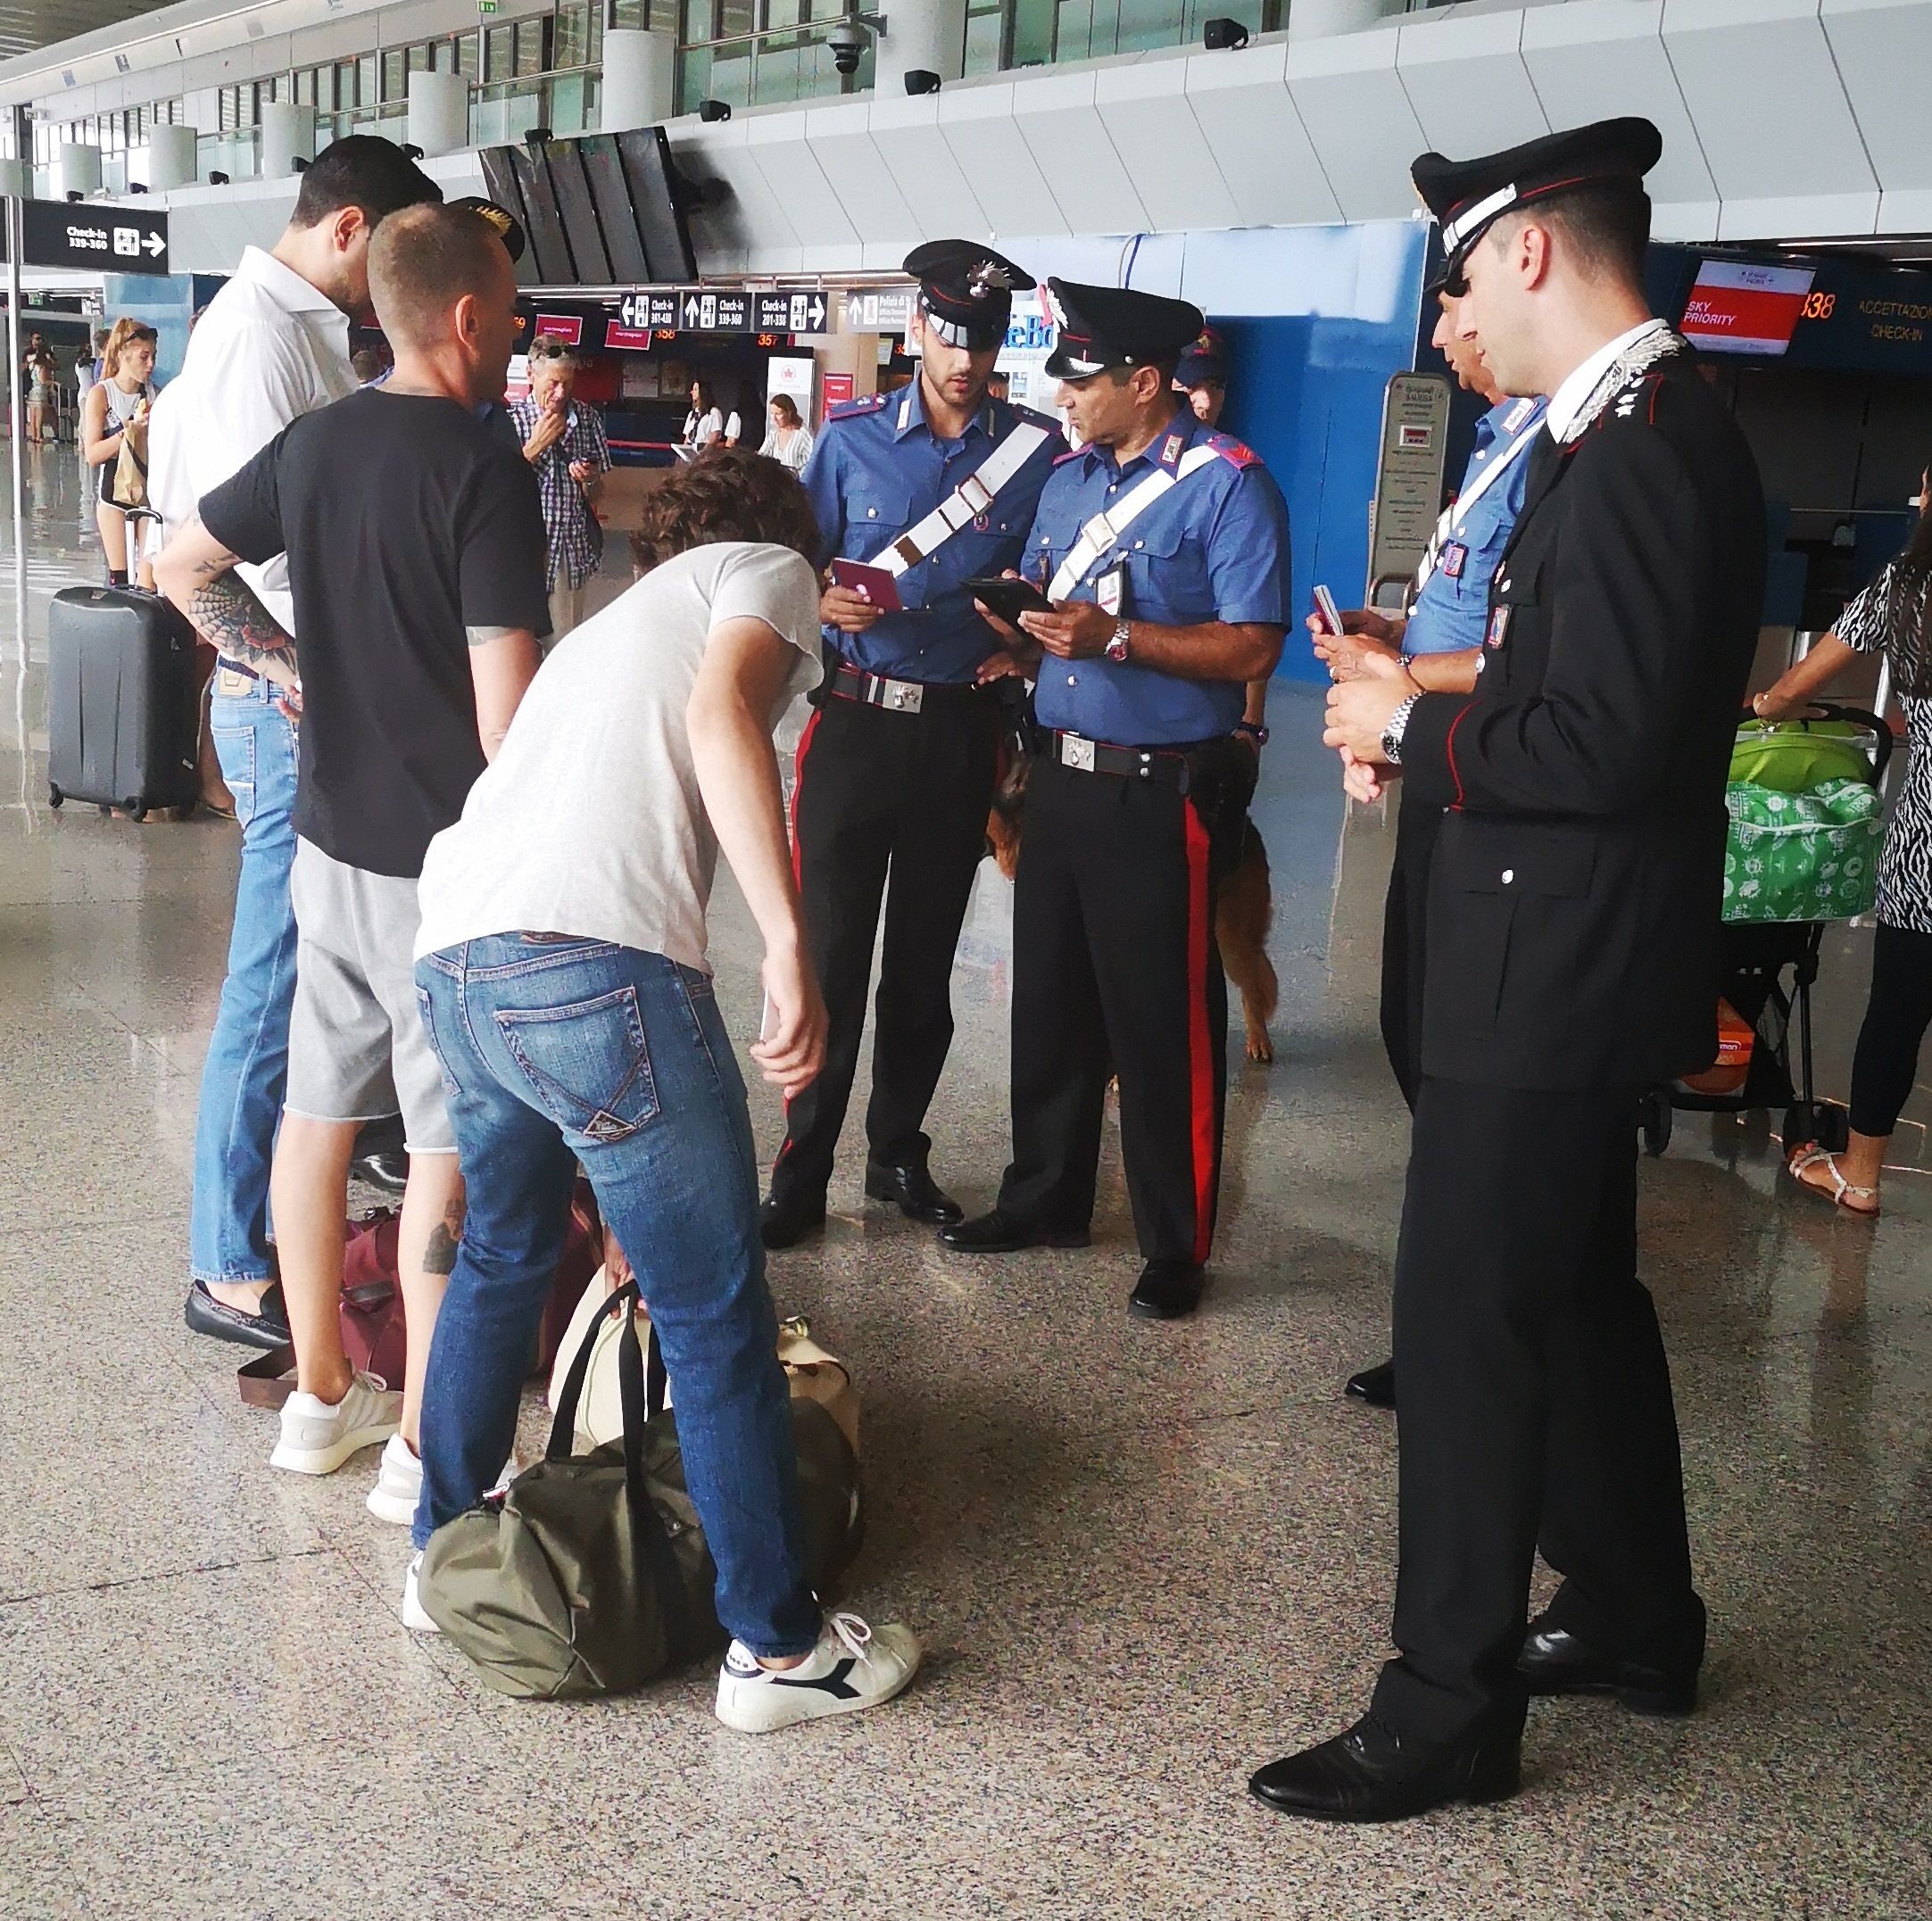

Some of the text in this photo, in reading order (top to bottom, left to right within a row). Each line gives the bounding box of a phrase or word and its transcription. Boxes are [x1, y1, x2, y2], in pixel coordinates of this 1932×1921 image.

[66, 226, 107, 240] Check-in
[69, 237, 108, 250] 339-360
[651, 299, 674, 311] Check-in
[719, 299, 744, 311] Check-in
[761, 299, 787, 311] Check-in
[1687, 301, 1712, 312] SKY
[1683, 311, 1737, 327] PRIORITY
[1870, 324, 1924, 342] CHECK-IN
[758, 334, 778, 346] 357
